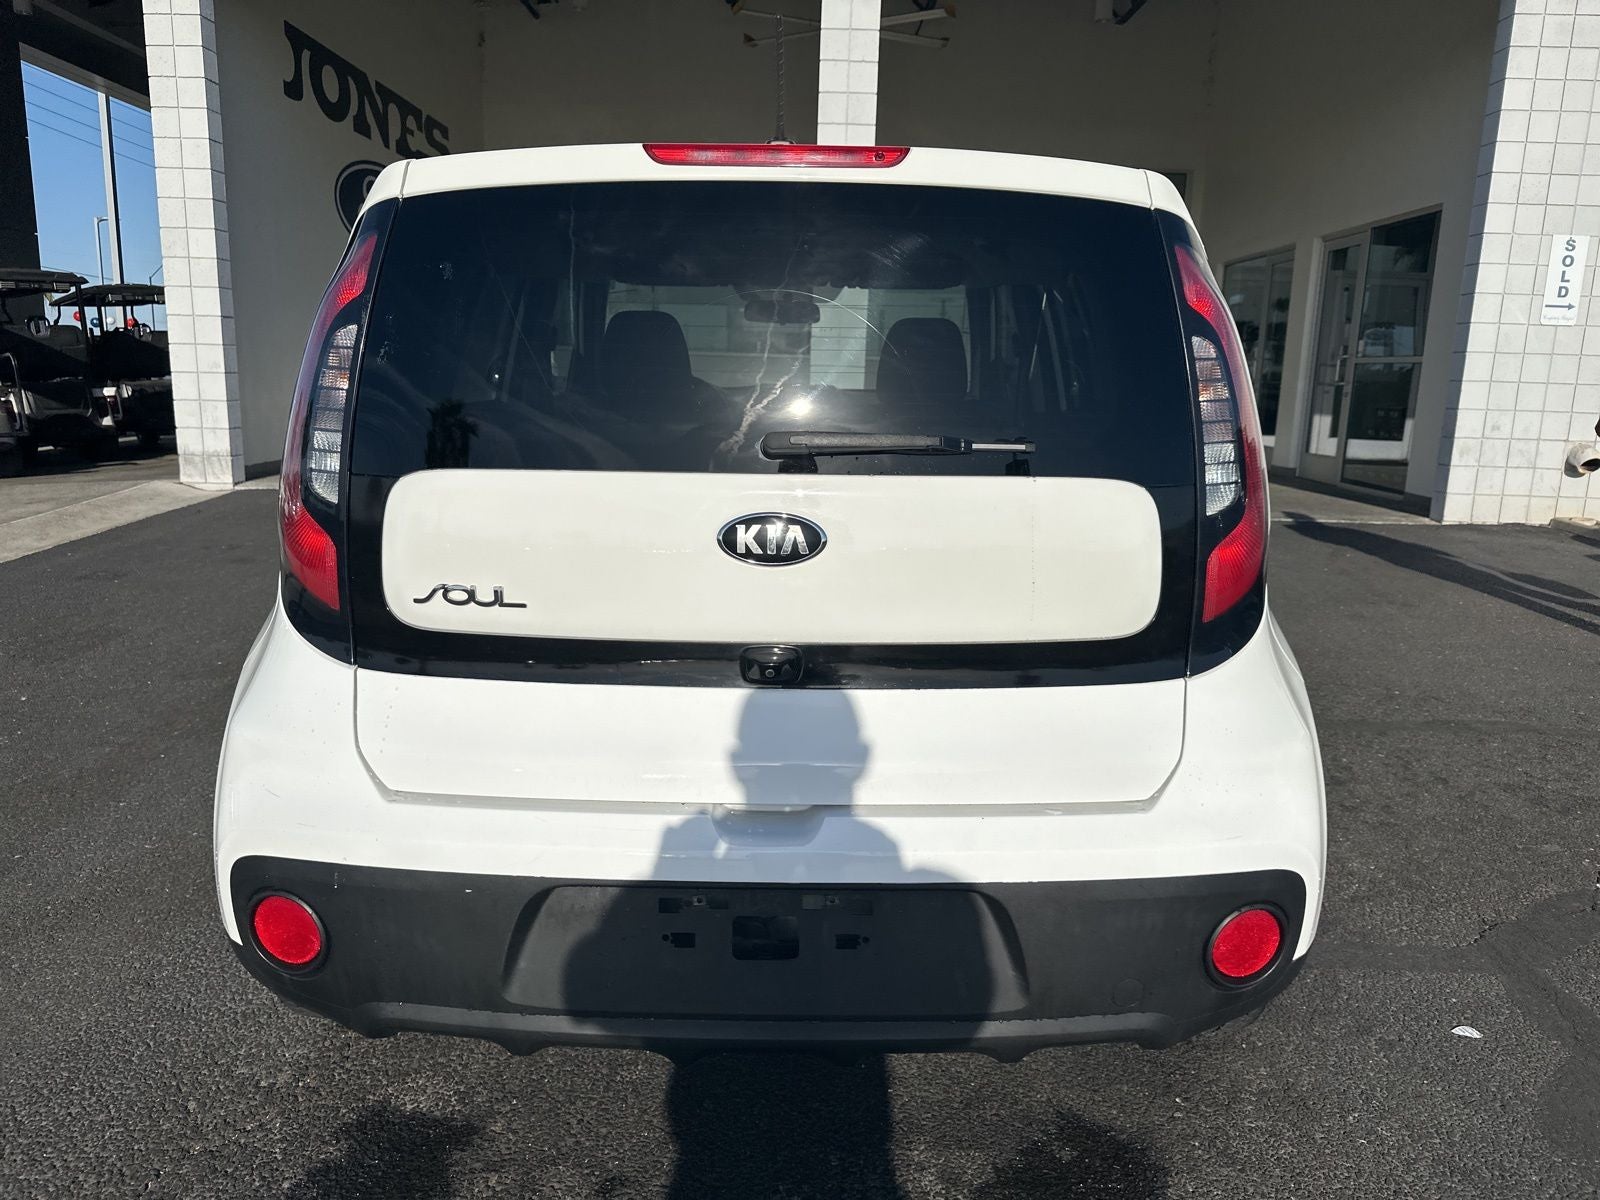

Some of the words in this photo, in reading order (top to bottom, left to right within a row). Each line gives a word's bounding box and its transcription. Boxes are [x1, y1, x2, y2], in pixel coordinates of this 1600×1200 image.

[283, 20, 449, 158] JONES
[1557, 238, 1576, 298] SOLD
[736, 524, 809, 555] KIA
[413, 584, 527, 608] SOUL
